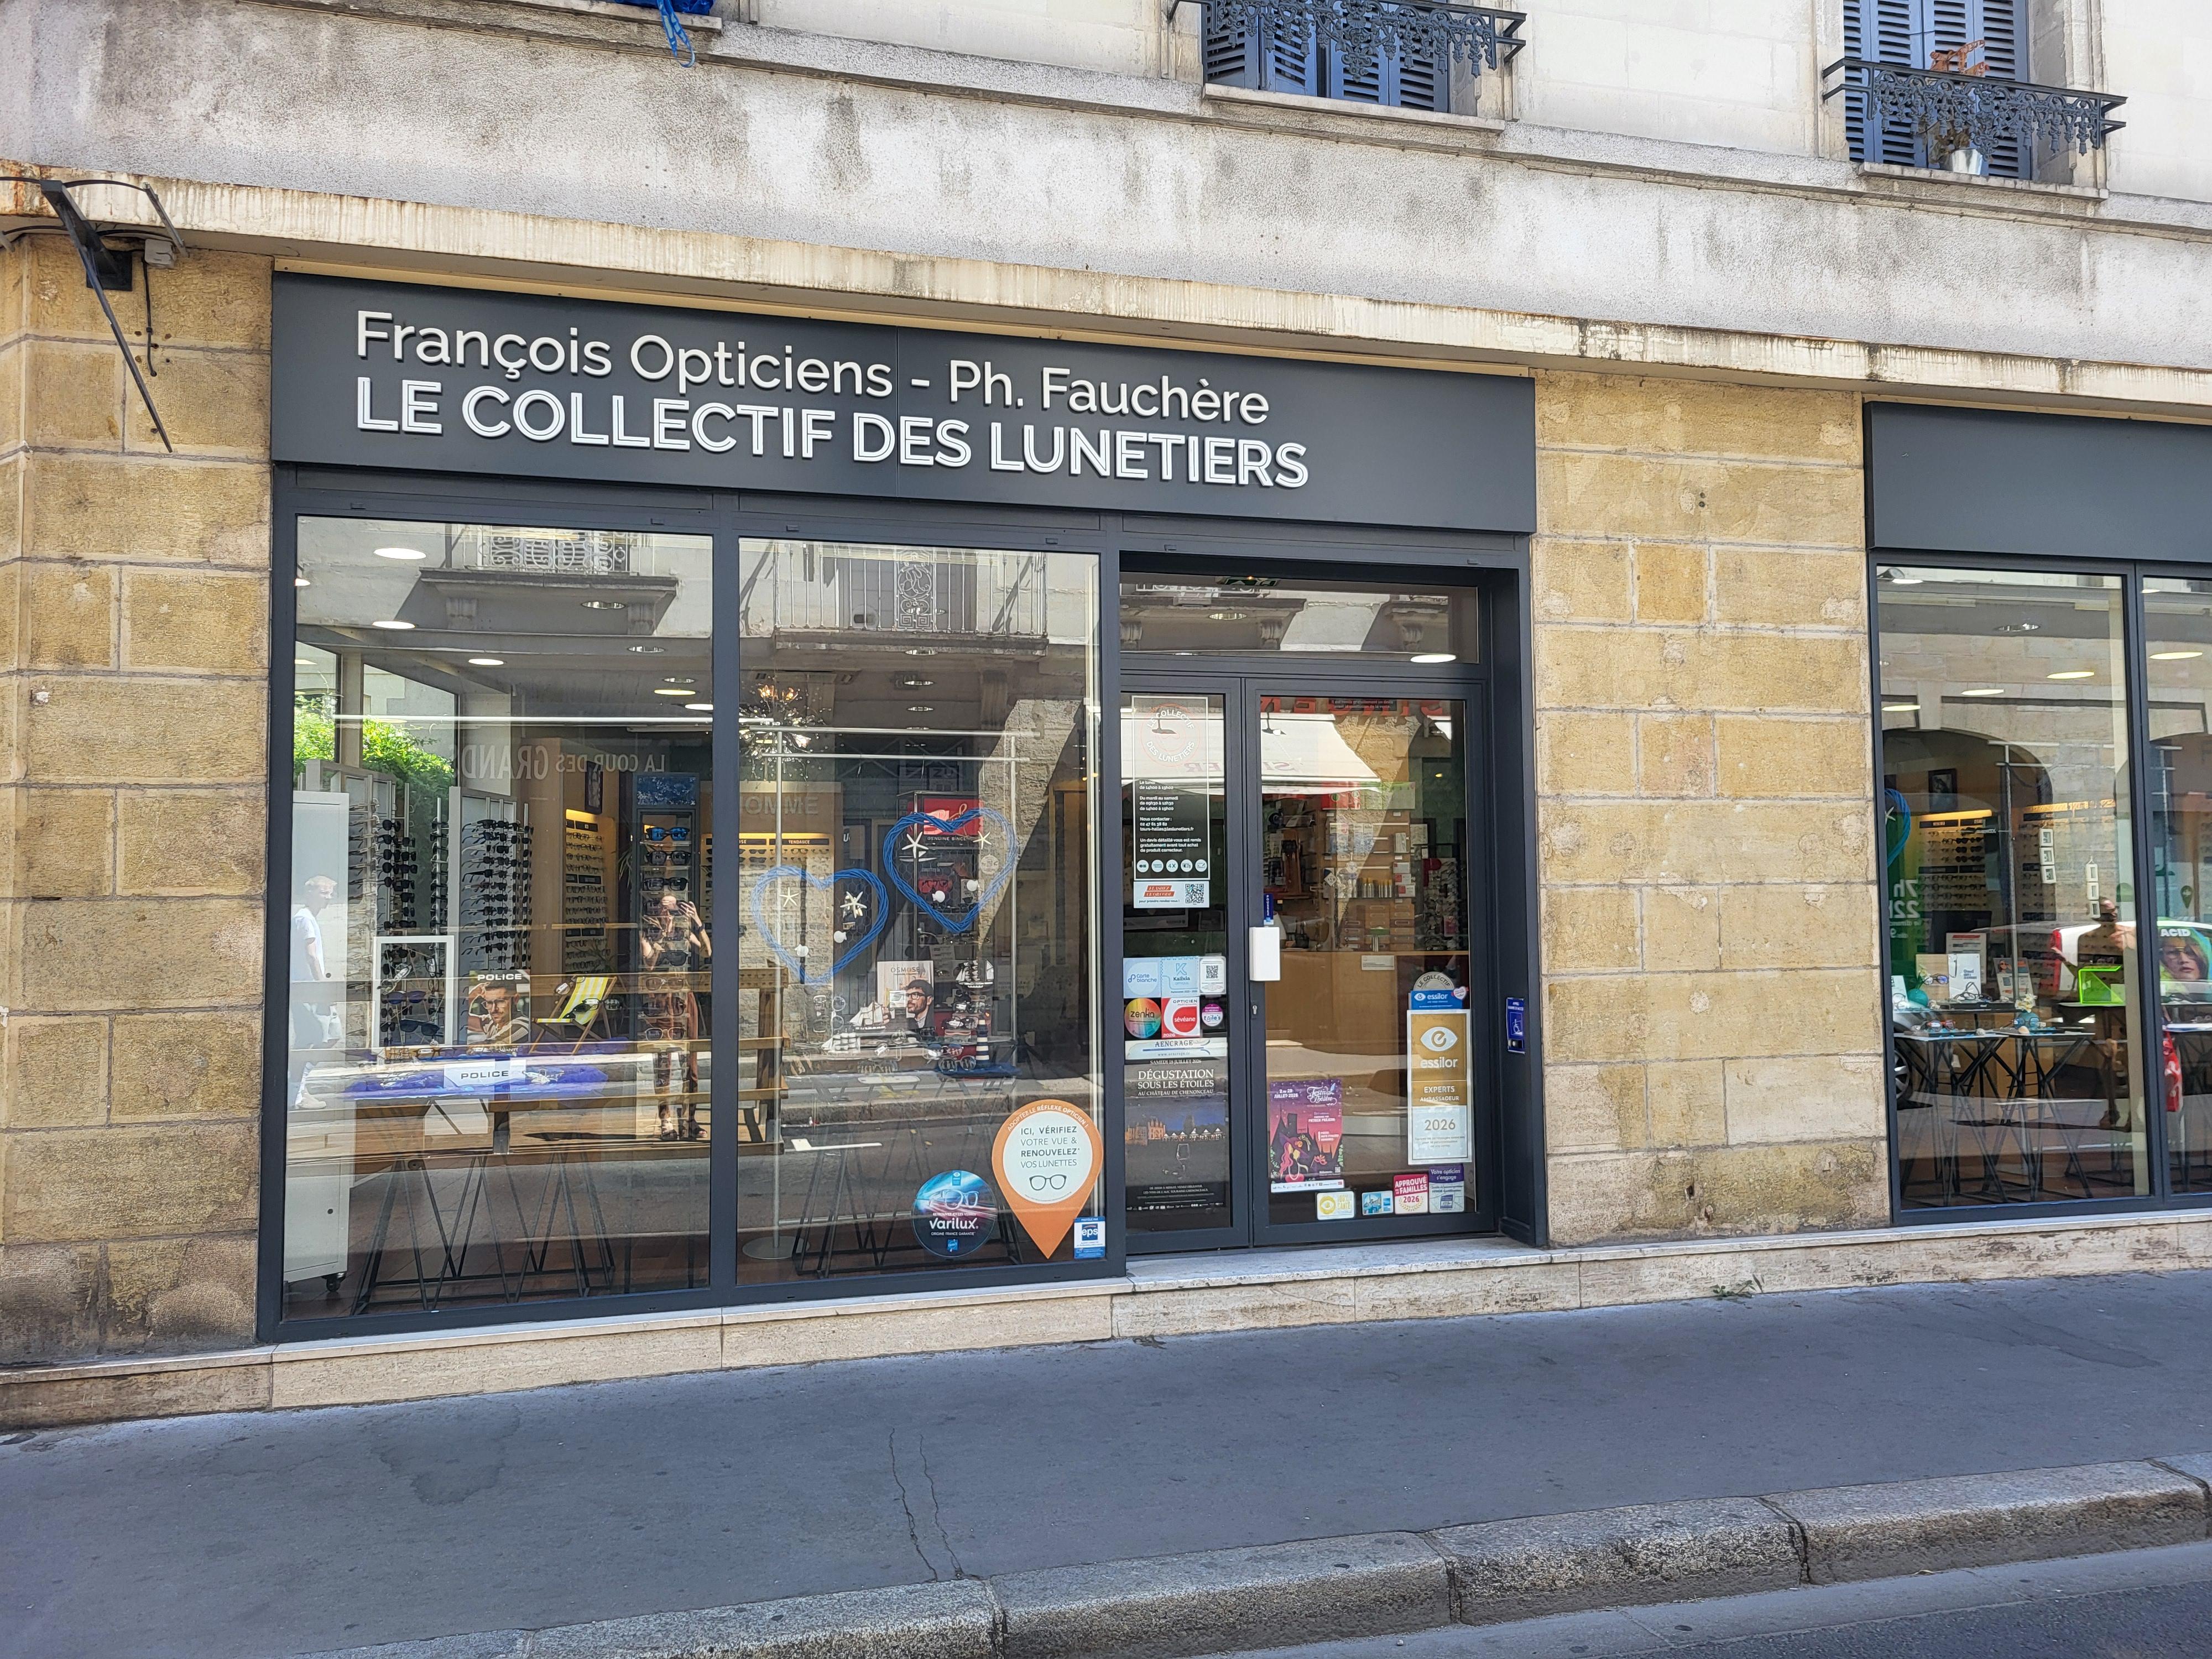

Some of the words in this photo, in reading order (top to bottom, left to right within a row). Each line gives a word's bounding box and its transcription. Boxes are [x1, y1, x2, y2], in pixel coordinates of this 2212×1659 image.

[357, 310, 612, 380] François
[630, 334, 893, 397] Opticiens
[911, 378, 930, 388] -
[950, 359, 1024, 407] Ph.
[1042, 366, 1269, 424] Fauchère
[357, 377, 442, 434] LE
[462, 385, 836, 458] COLLECTIF
[853, 412, 972, 468] DES
[990, 422, 1309, 488] LUNETIERS
[1156, 709, 1194, 729] COLLECTIF
[1146, 741, 1159, 755] DES
[1159, 742, 1195, 762] LUNETIERS
[2160, 928, 2190, 937] ACID
[1423, 975, 1450, 987] COLLECTIF
[1420, 1057, 1458, 1068] essilor
[461, 1071, 509, 1079] POLICE
[1138, 1069, 1214, 1079] DÉGUSTATION
[1138, 1081, 1161, 1089] SOUS
[1180, 1079, 1214, 1088] ÉTOILES
[1307, 1086, 1334, 1098] Festival
[1007, 1111, 1029, 1131] ADOPTEZ
[1062, 1107, 1086, 1125] OPTICIEN
[1039, 1125, 1077, 1134] VÉRIFIEZ
[1425, 1119, 1455, 1131] 2026
[1039, 1159, 1077, 1167] LUNETTES
[1395, 1176, 1427, 1188] APPROUVÉ
[1400, 1184, 1427, 1194] FAMILLES
[1082, 1228, 1098, 1238] eps
